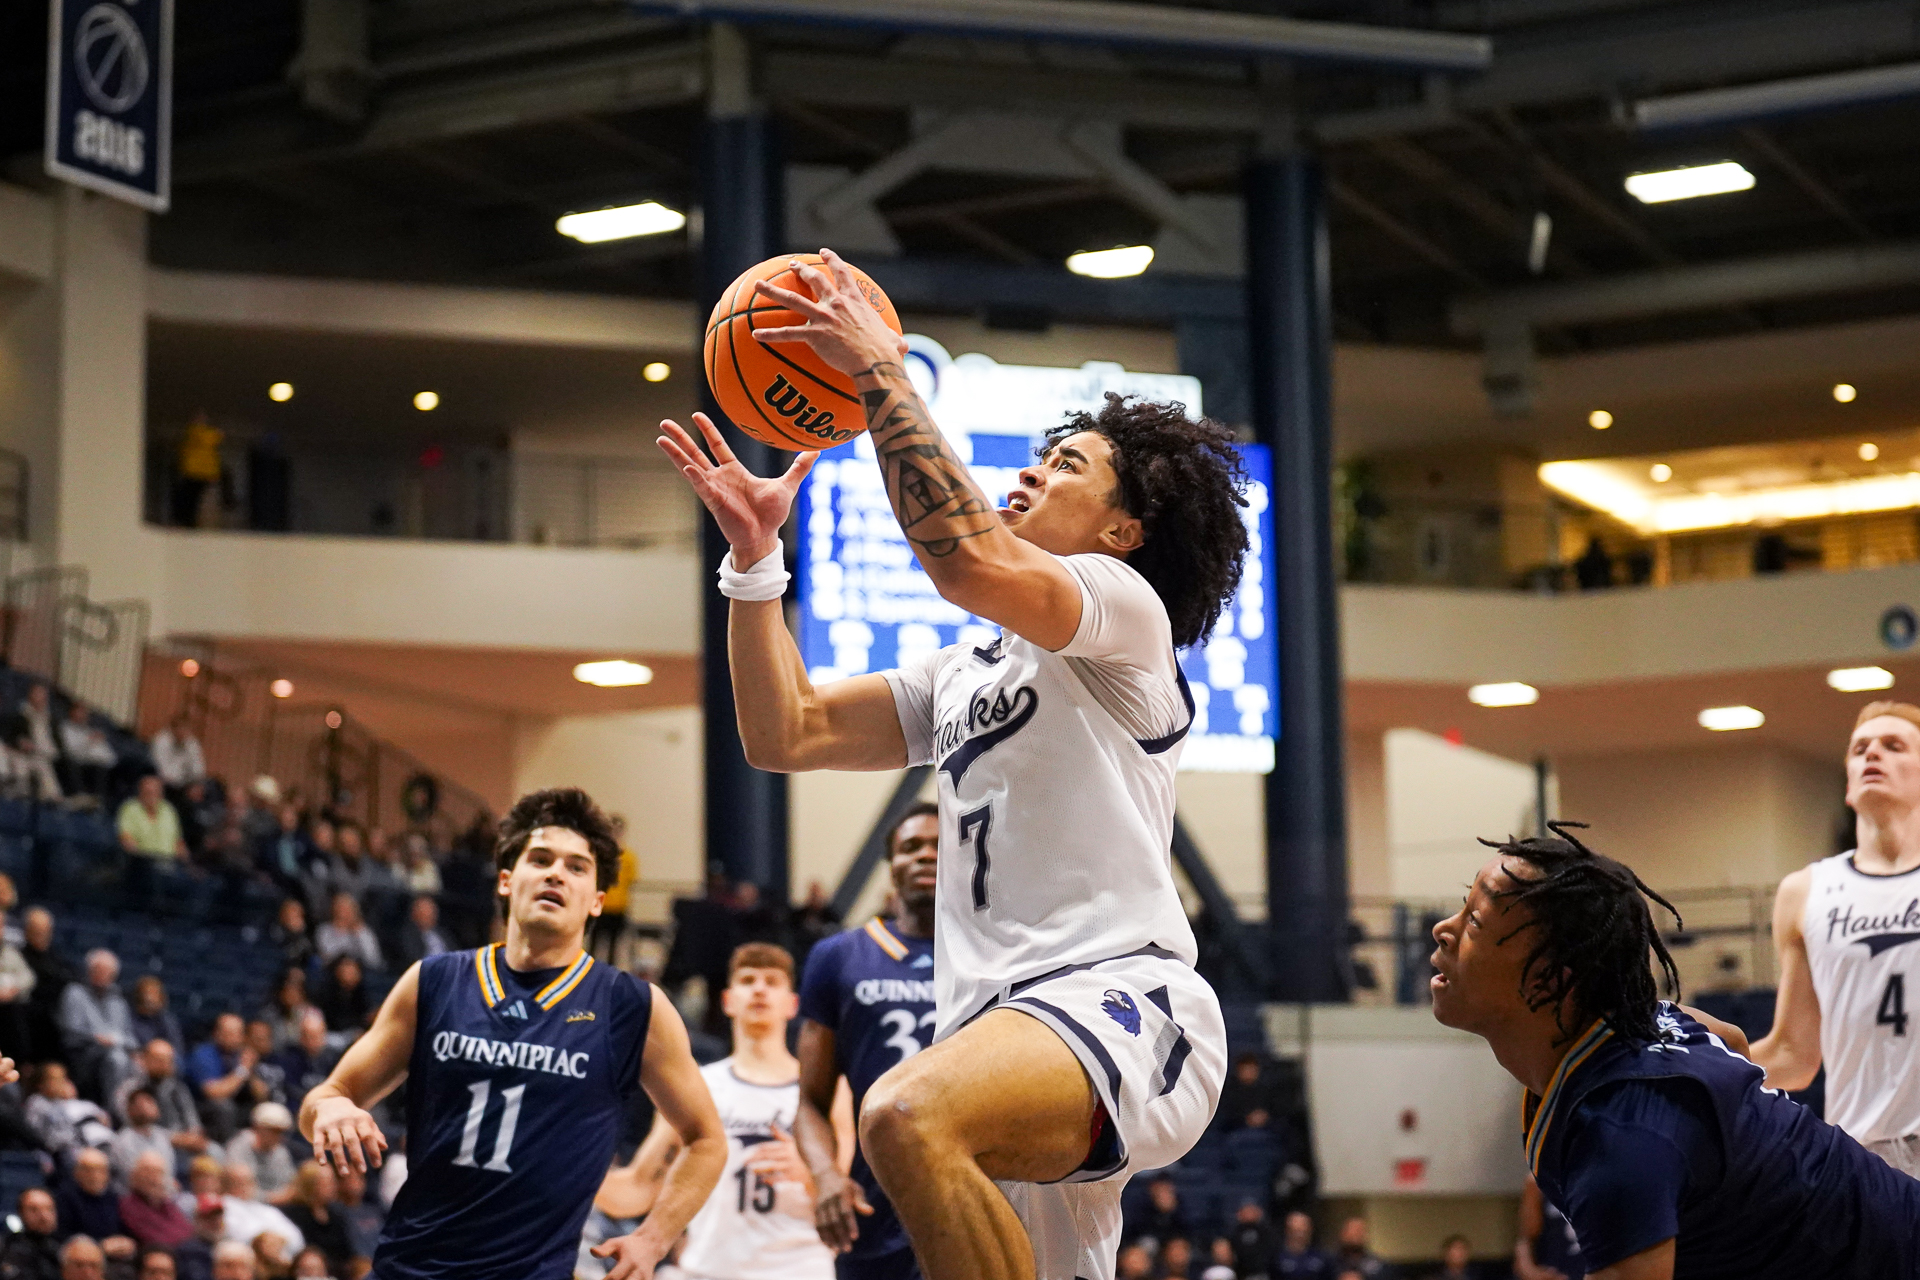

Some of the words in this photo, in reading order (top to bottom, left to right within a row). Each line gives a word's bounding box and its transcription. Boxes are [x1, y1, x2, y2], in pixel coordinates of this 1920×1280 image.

[957, 799, 994, 914] 7
[1876, 972, 1909, 1037] 4
[433, 1031, 590, 1079] QUINNIPIAC
[451, 1078, 527, 1173] 11
[733, 1166, 776, 1214] 15
